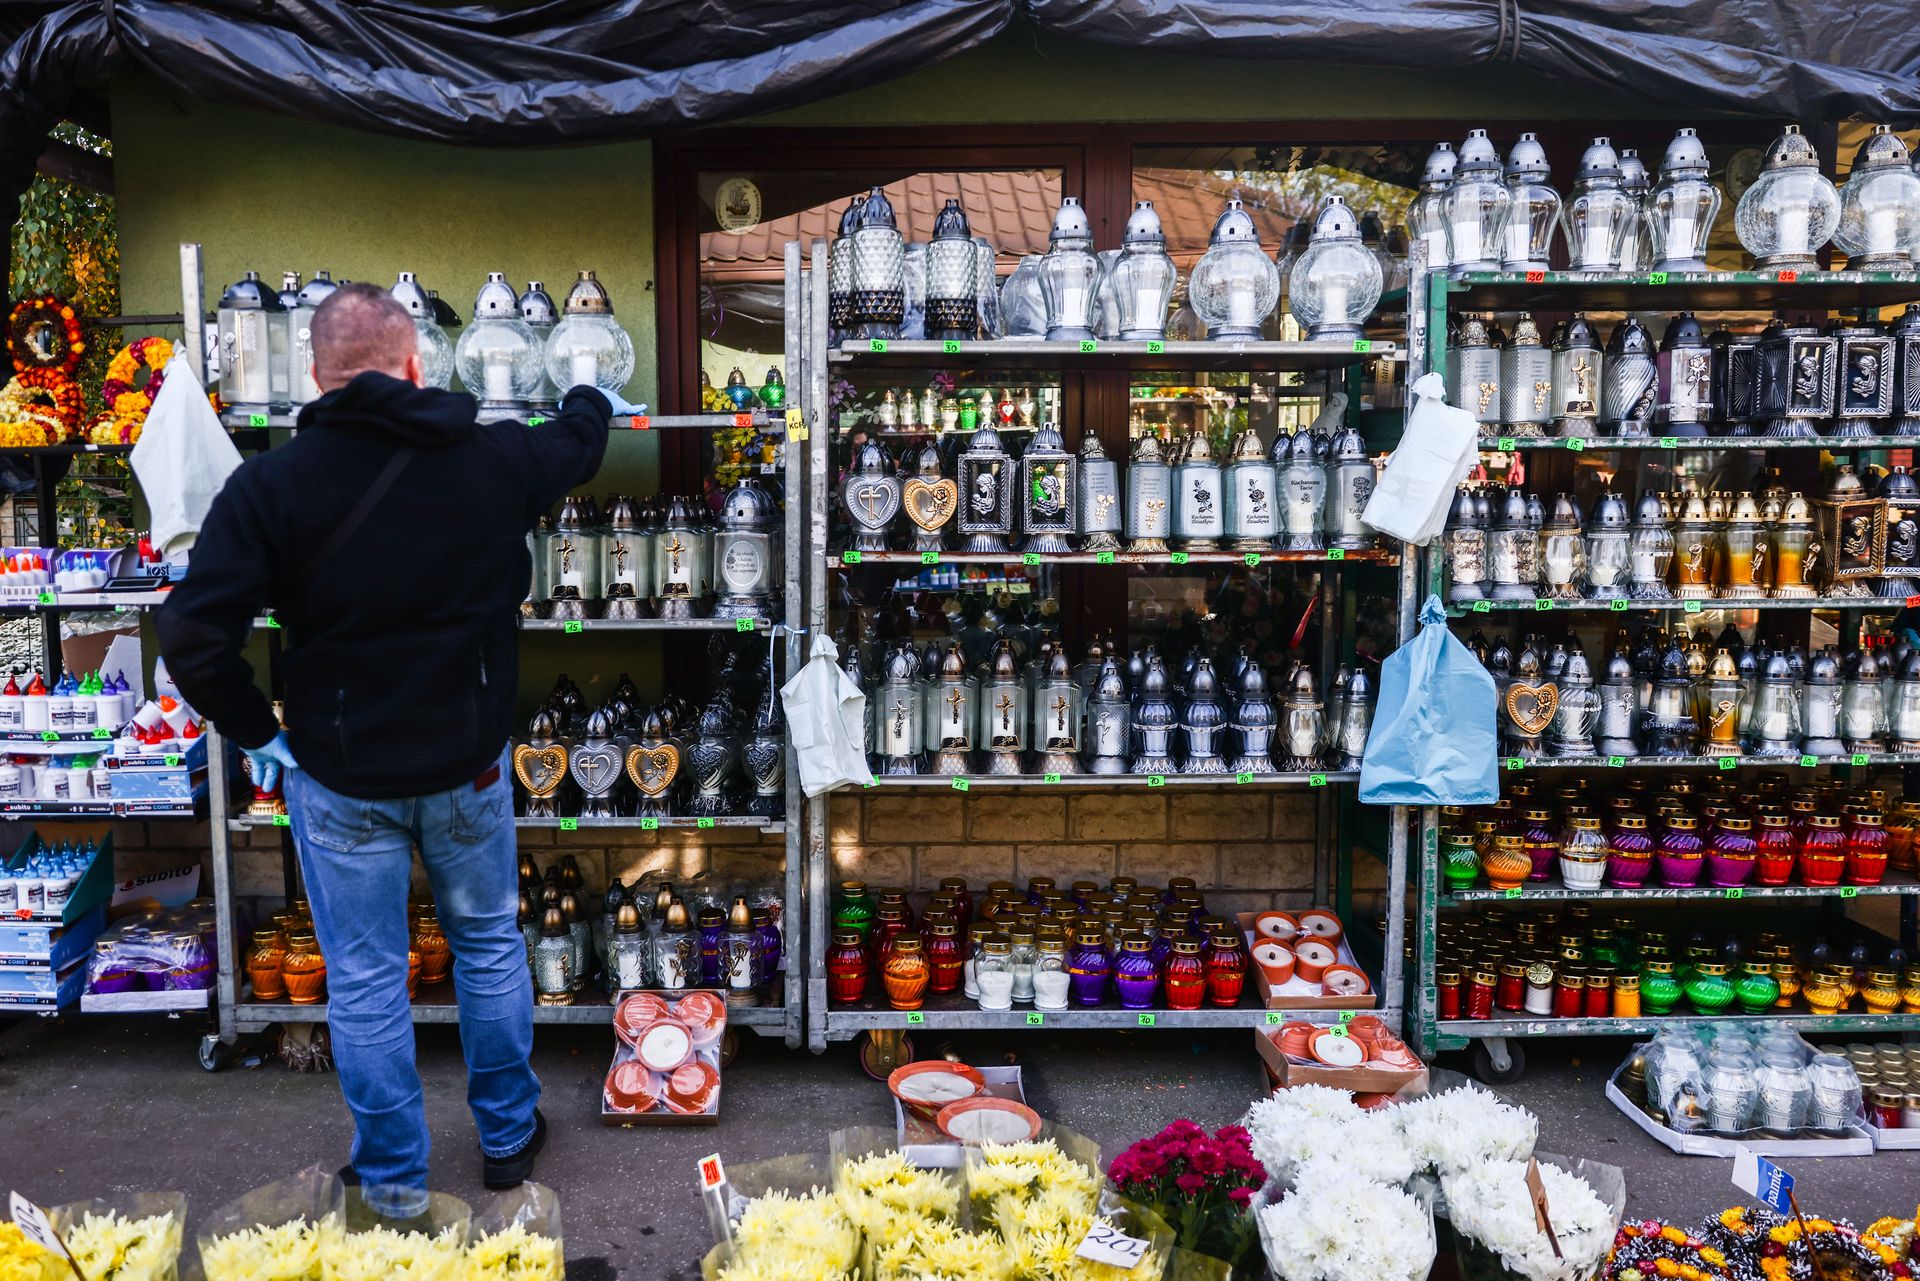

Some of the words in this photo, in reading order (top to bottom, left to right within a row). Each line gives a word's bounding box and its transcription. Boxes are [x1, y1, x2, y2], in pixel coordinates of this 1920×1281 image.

[1529, 273, 1543, 282] 20
[1652, 274, 1664, 283] 20
[871, 342, 883, 350] 30
[945, 344, 957, 353] 30
[1082, 342, 1093, 351] 20
[1149, 344, 1160, 352] 20
[253, 416, 264, 426] 30
[1501, 441, 1512, 450] 15
[1570, 440, 1579, 449] 15
[847, 554, 857, 562] 12
[1174, 555, 1184, 563] 15
[1329, 551, 1340, 559] 15
[924, 556, 934, 564] 12
[1026, 556, 1036, 564] 15
[1247, 556, 1256, 564] 15
[43, 595, 49, 603] 8
[1539, 600, 1549, 609] 10
[1614, 600, 1623, 609] 10
[568, 622, 578, 631] 15
[740, 622, 750, 631] 25
[98, 729, 107, 737] 12
[1511, 760, 1519, 769] 12
[1047, 774, 1056, 782] 15
[1239, 775, 1249, 783] 10
[1312, 777, 1321, 785] 10
[564, 821, 573, 829] 12
[643, 820, 654, 828] 12
[1729, 889, 1738, 897] 10
[1843, 888, 1853, 896] 10
[1030, 1017, 1039, 1025] 10
[1140, 1016, 1151, 1024] 10
[1268, 1016, 1278, 1024] 10
[1341, 1013, 1351, 1021] 10
[1334, 1029, 1342, 1037] 8
[703, 1159, 719, 1180] 20
[1088, 1227, 1137, 1253] 20
